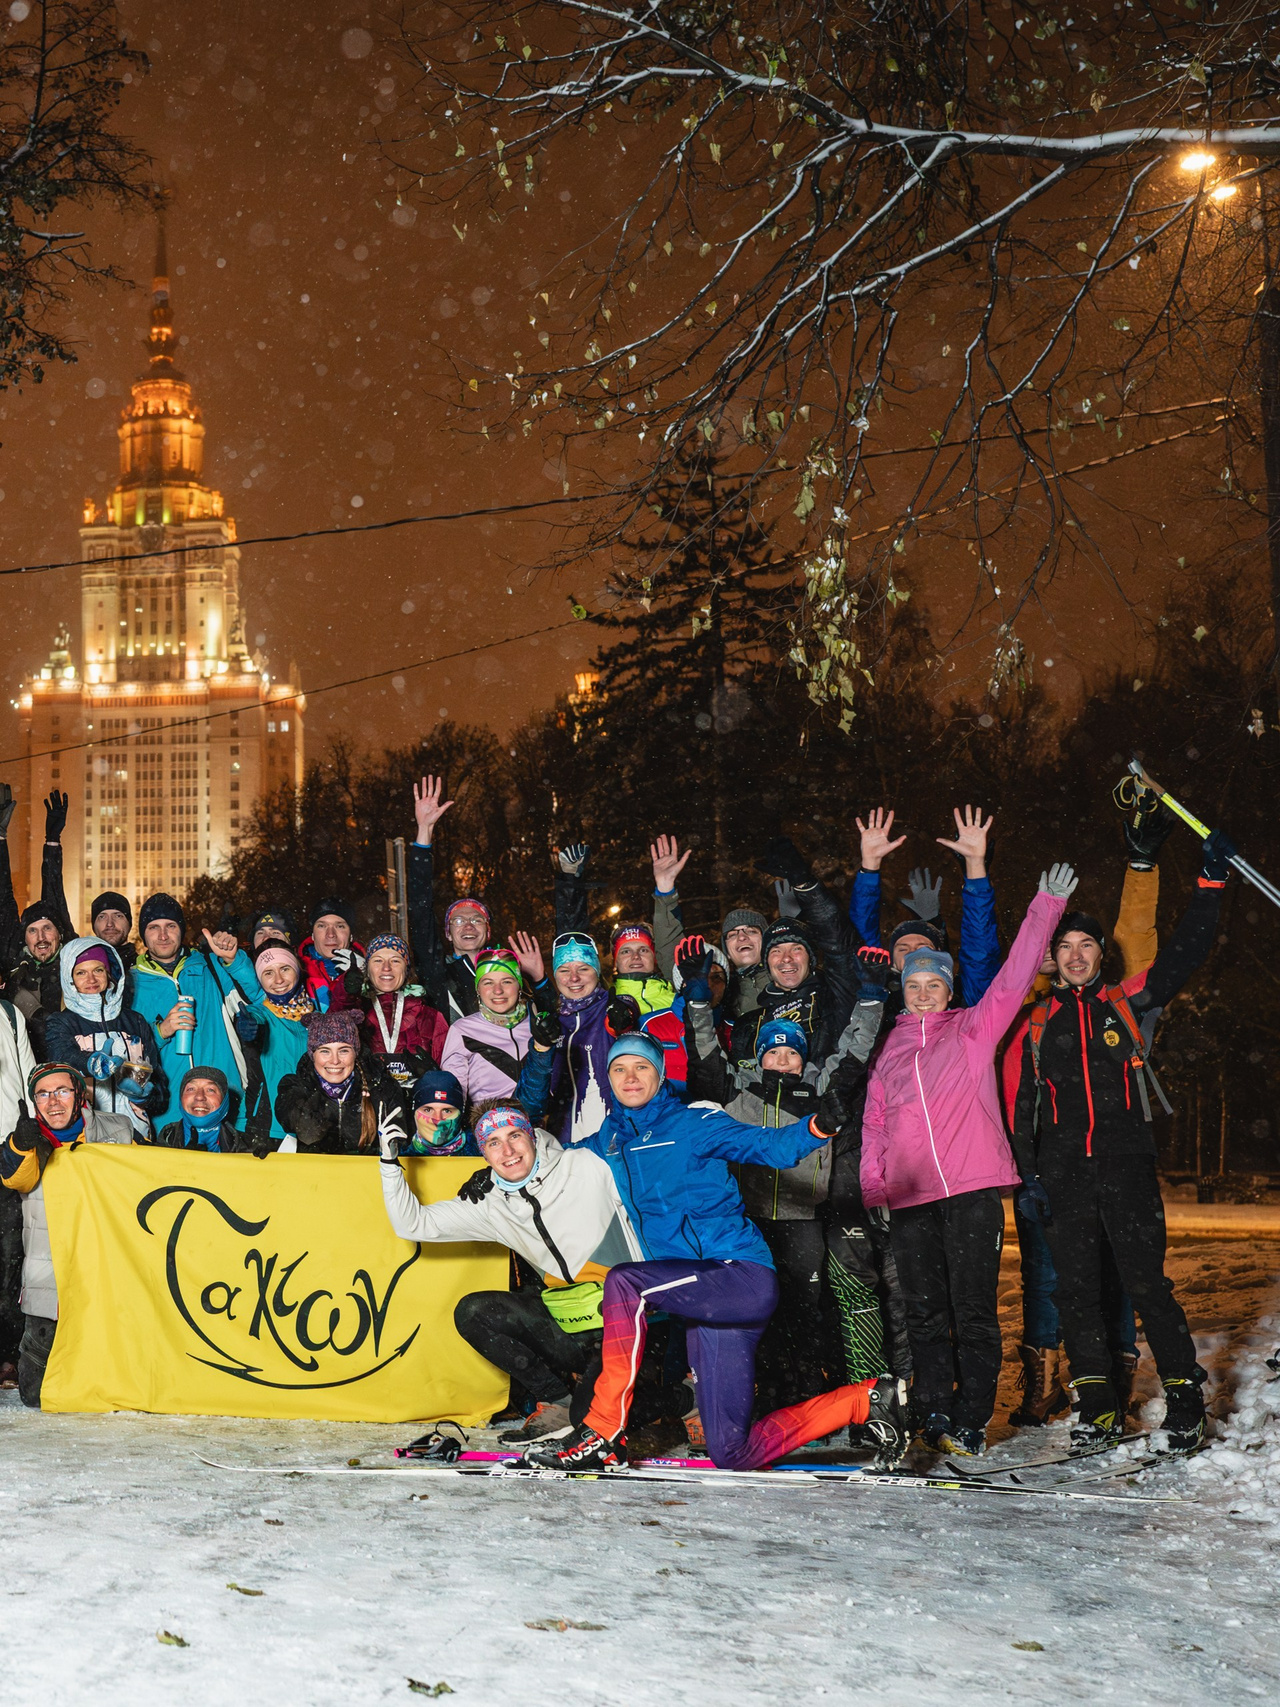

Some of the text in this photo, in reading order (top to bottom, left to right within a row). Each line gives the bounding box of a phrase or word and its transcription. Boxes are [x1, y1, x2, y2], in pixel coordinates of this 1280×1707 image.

[553, 1312, 595, 1324] NEWAY
[488, 1469, 567, 1480] FISCHER
[846, 1475, 928, 1487] FISCHER
